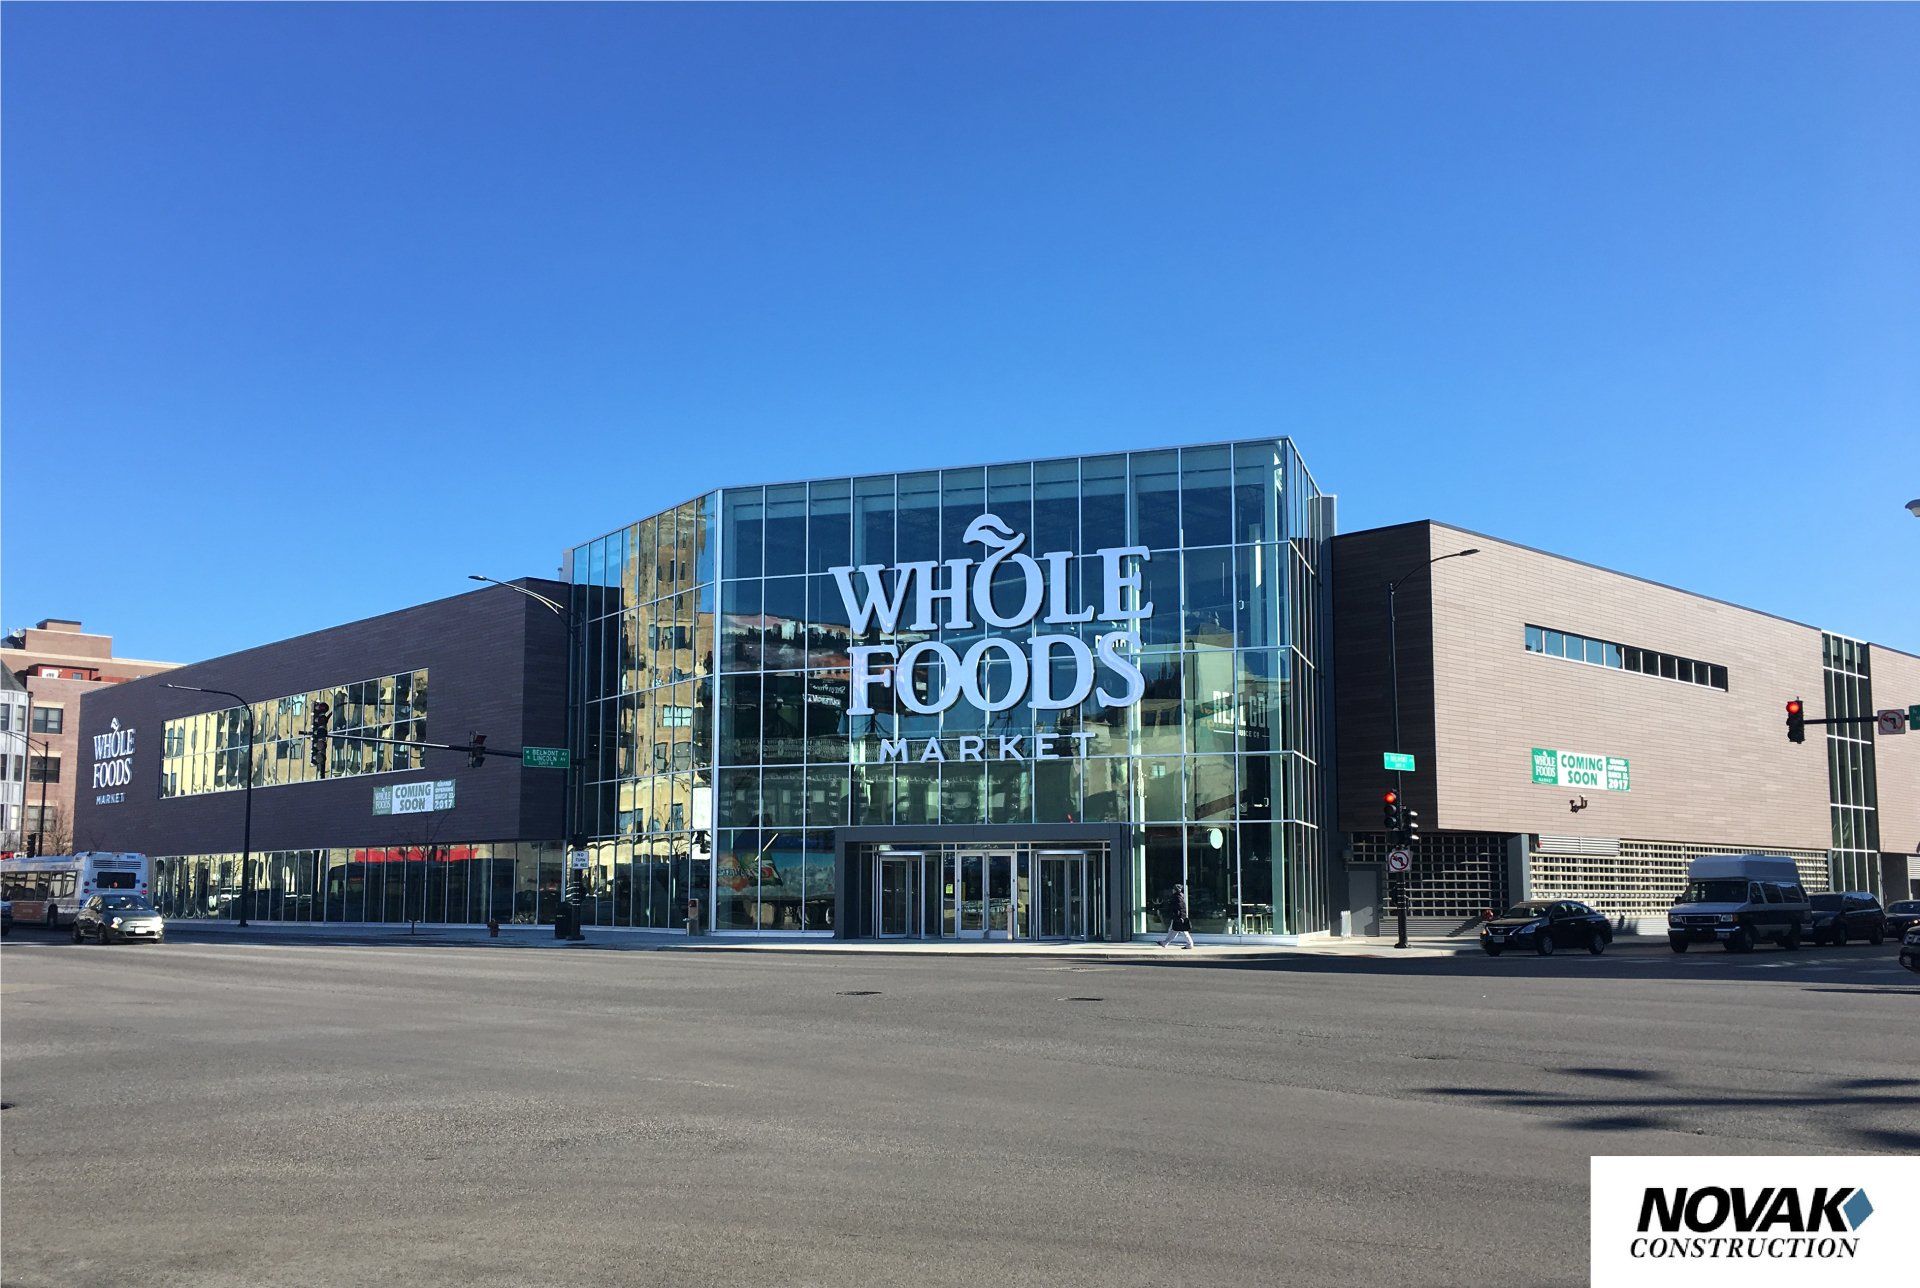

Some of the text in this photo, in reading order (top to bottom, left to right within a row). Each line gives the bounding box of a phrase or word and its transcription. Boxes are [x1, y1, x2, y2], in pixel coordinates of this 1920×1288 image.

[828, 540, 1154, 636] WHOLE
[846, 631, 1146, 716] FOODS
[93, 728, 136, 761] WHOLE
[879, 732, 1096, 764] MARKET
[532, 749, 559, 757] BELMONT
[1533, 754, 1556, 767] WHOLE
[1561, 754, 1603, 772] COMING
[92, 758, 132, 789] FOODS
[1535, 766, 1556, 778] FOODS
[1567, 770, 1598, 786] SOON
[395, 784, 431, 799] COMING
[1608, 778, 1628, 790] 2017
[96, 792, 125, 805] MARKET
[400, 797, 426, 812] SOON
[434, 799, 452, 810] 2017
